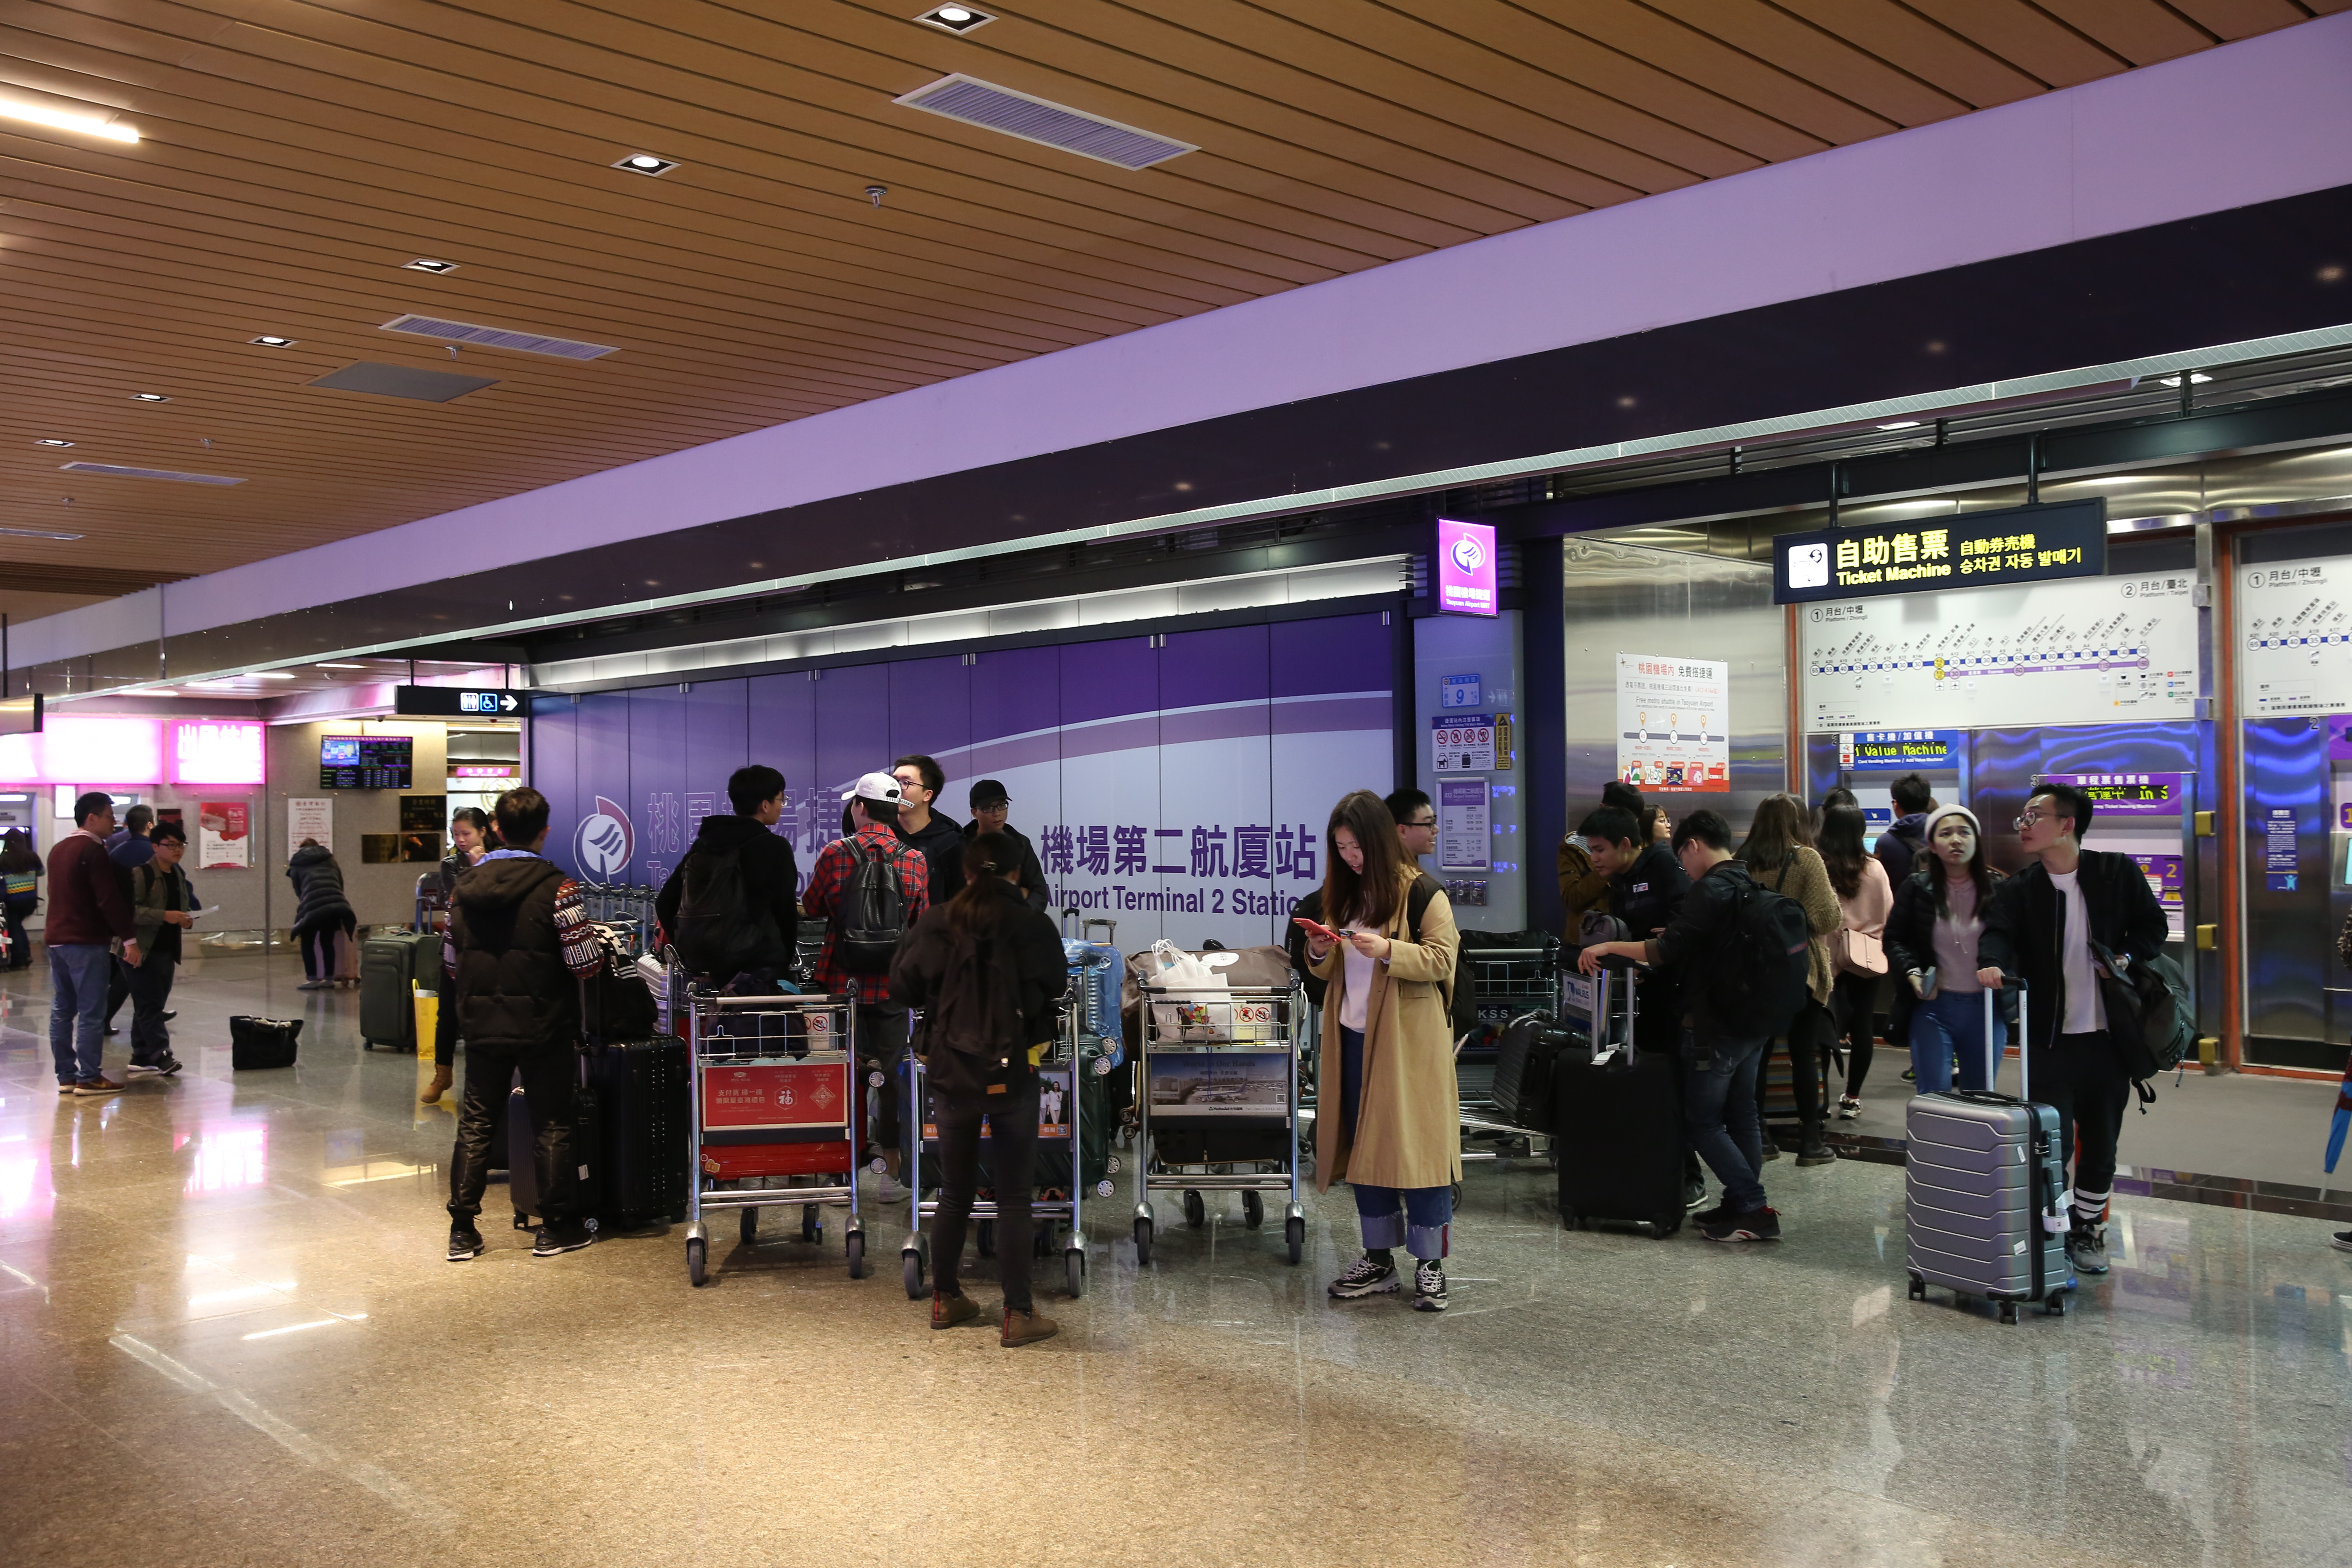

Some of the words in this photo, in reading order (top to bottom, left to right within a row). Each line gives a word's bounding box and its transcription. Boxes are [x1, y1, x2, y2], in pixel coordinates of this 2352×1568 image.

[1837, 529, 1949, 569] 自助售票
[1960, 534, 2036, 557] 自動券売機
[1959, 557, 2001, 575] 승차권
[2005, 554, 2034, 569] 자동
[2039, 547, 2082, 566] 발매기
[1836, 568, 1883, 586] Ticket
[1885, 564, 1951, 582] Machine
[1446, 599, 1465, 607] Taoyuan
[1638, 662, 1674, 676] 桃園機場內
[1678, 666, 1713, 679] 免費搭捷運
[1456, 689, 1464, 704] 9
[1682, 699, 1699, 707] Taoyuan
[2309, 717, 2319, 731] 2
[1866, 731, 1934, 742] 售卡機/加值機
[1864, 744, 1898, 756] Value
[1902, 742, 1947, 755] Machine
[2030, 775, 2039, 788] 3
[2077, 775, 2149, 785] 單程票售票機
[1040, 824, 1316, 880] 機場第二航廈站
[2166, 864, 2177, 878] 2
[1113, 886, 1203, 913] Terminal
[1212, 888, 1225, 913] 2
[1232, 889, 1306, 916] Statio
